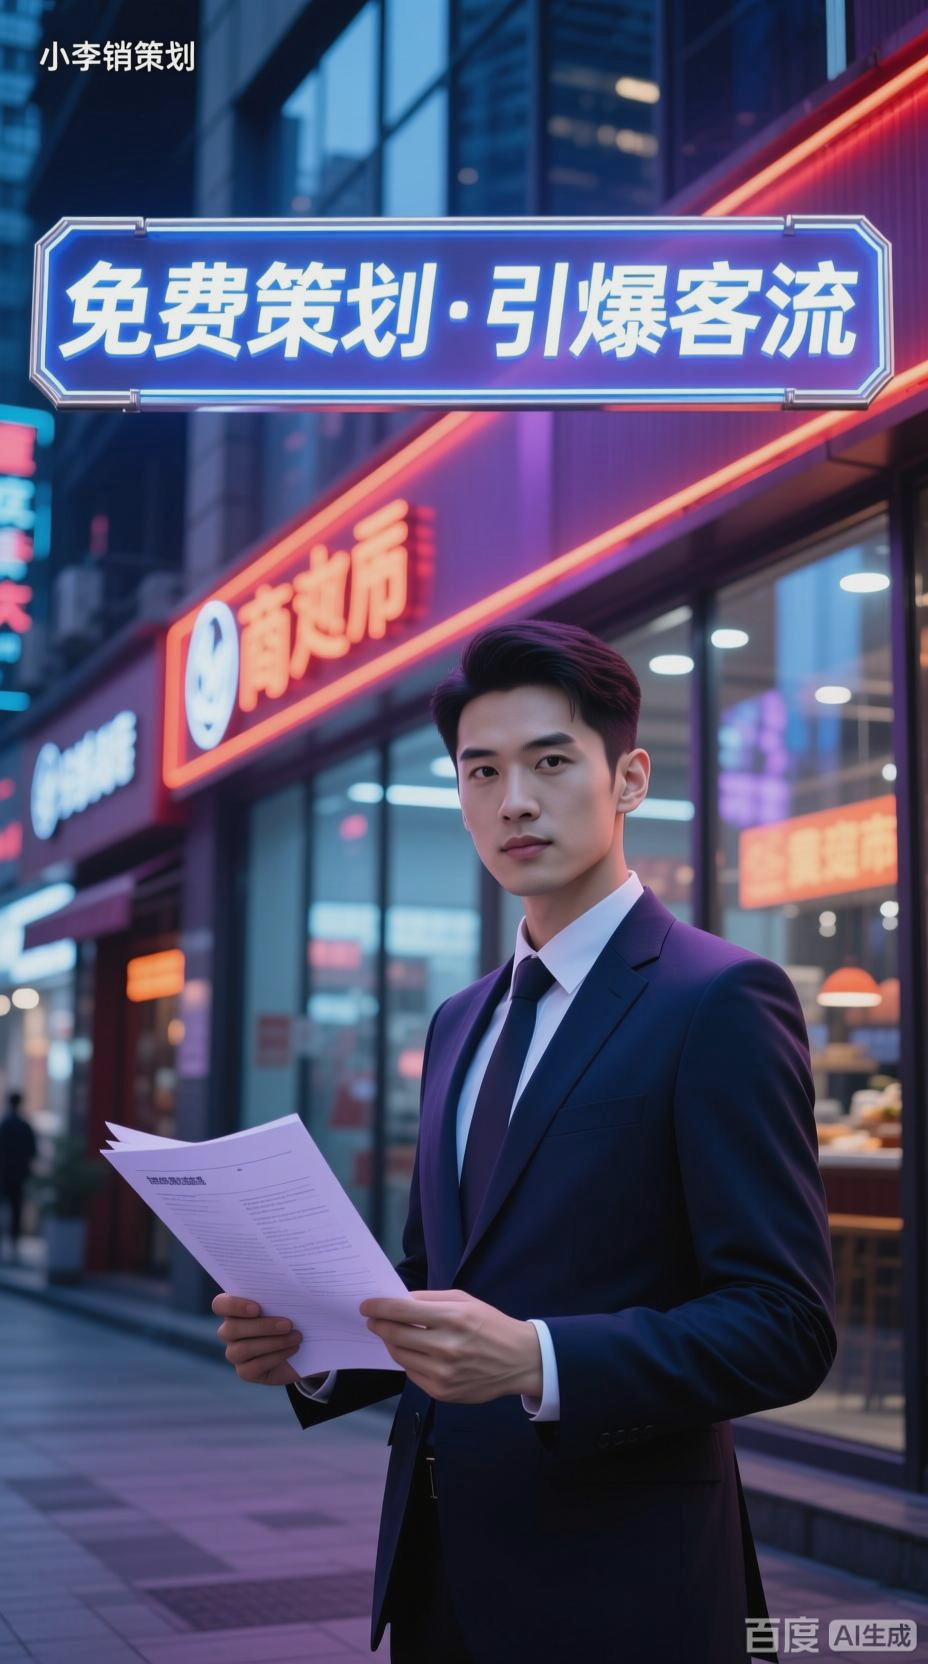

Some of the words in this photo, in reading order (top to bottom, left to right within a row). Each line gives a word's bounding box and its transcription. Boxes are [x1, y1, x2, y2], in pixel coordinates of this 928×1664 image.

[58, 260, 860, 359] 免费策划·引爆客流
